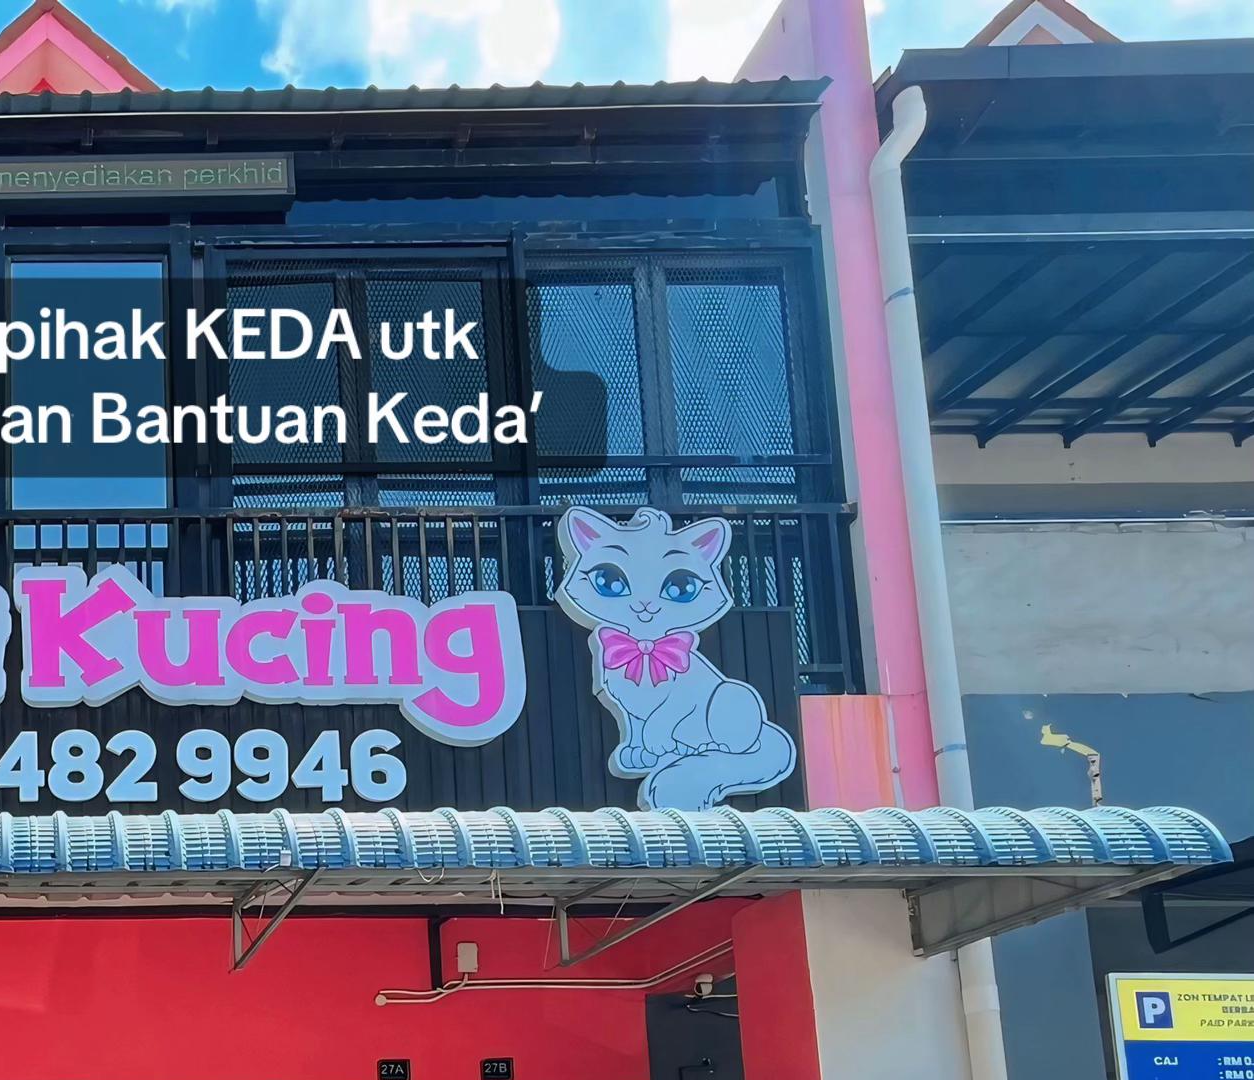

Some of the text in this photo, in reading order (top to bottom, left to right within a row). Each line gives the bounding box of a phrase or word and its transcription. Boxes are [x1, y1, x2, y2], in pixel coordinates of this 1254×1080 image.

[18, 575, 522, 728] Kucing
[176, 728, 407, 802] 9946
[1177, 993, 1199, 1002] ZON
[1201, 994, 1242, 1002] TEMPAT
[1144, 997, 1165, 1023] P
[1200, 1019, 1225, 1028] PAID
[1154, 1057, 1178, 1066] CAJ
[381, 1064, 405, 1075] 27A
[484, 1063, 507, 1073] 27B
